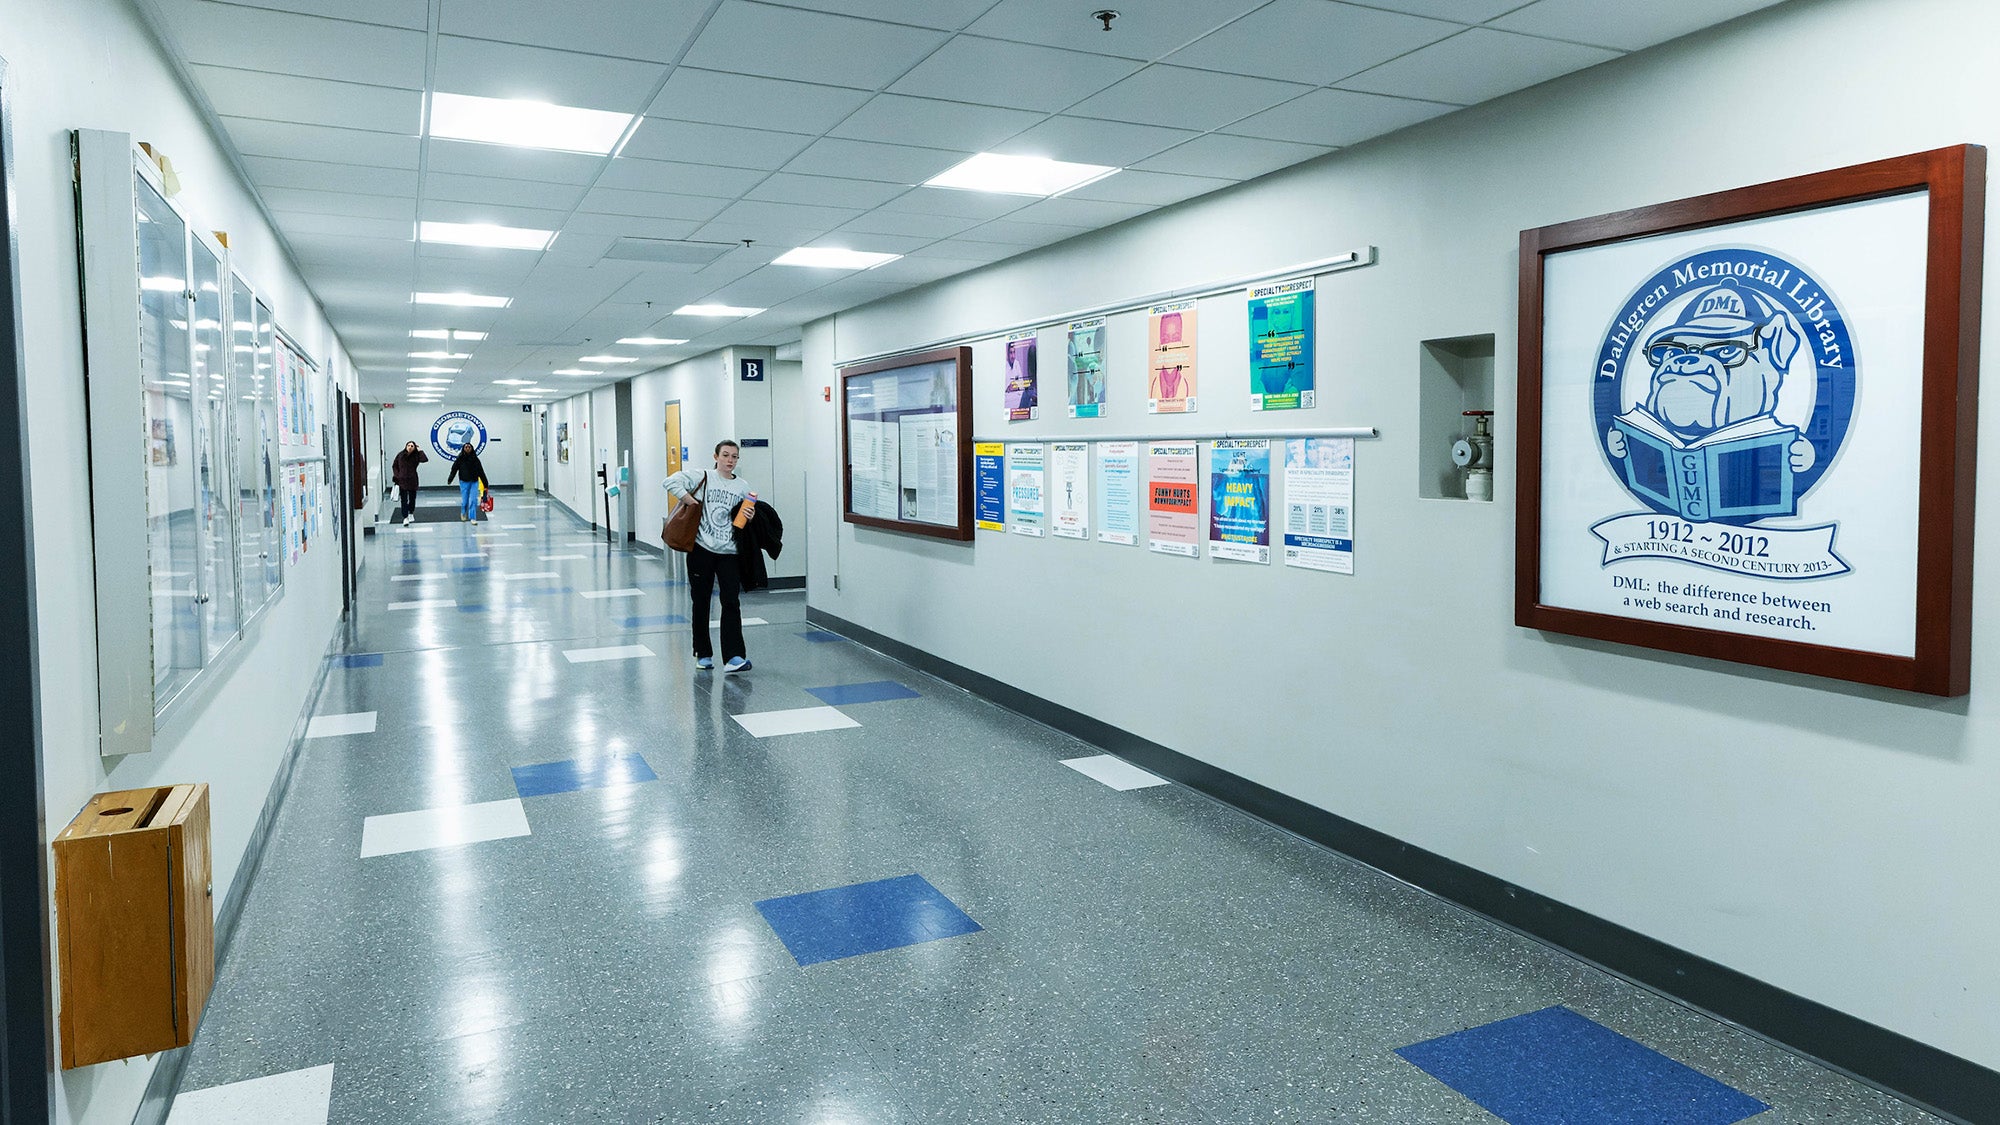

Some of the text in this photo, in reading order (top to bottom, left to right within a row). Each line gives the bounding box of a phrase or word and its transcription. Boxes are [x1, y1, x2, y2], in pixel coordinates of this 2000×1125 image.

[1700, 296, 1741, 314] DML
[1600, 260, 1843, 380] Dahlgren Memorial Library
[746, 362, 759, 378] B
[433, 412, 485, 430] GEORGETOWN
[1154, 487, 1191, 499] FUNNY HURTS
[1226, 482, 1253, 494] HEAVY
[1682, 454, 1702, 518] GUMC
[1225, 496, 1256, 508] IMPACT
[1647, 520, 1694, 544] 1912
[1717, 531, 1769, 558] 2012
[1613, 541, 1832, 573] & STARTING A SECOND CENTURY 2013-
[1613, 575, 1832, 613] DML: the difference between
[1623, 597, 1816, 631] a web search and research.
